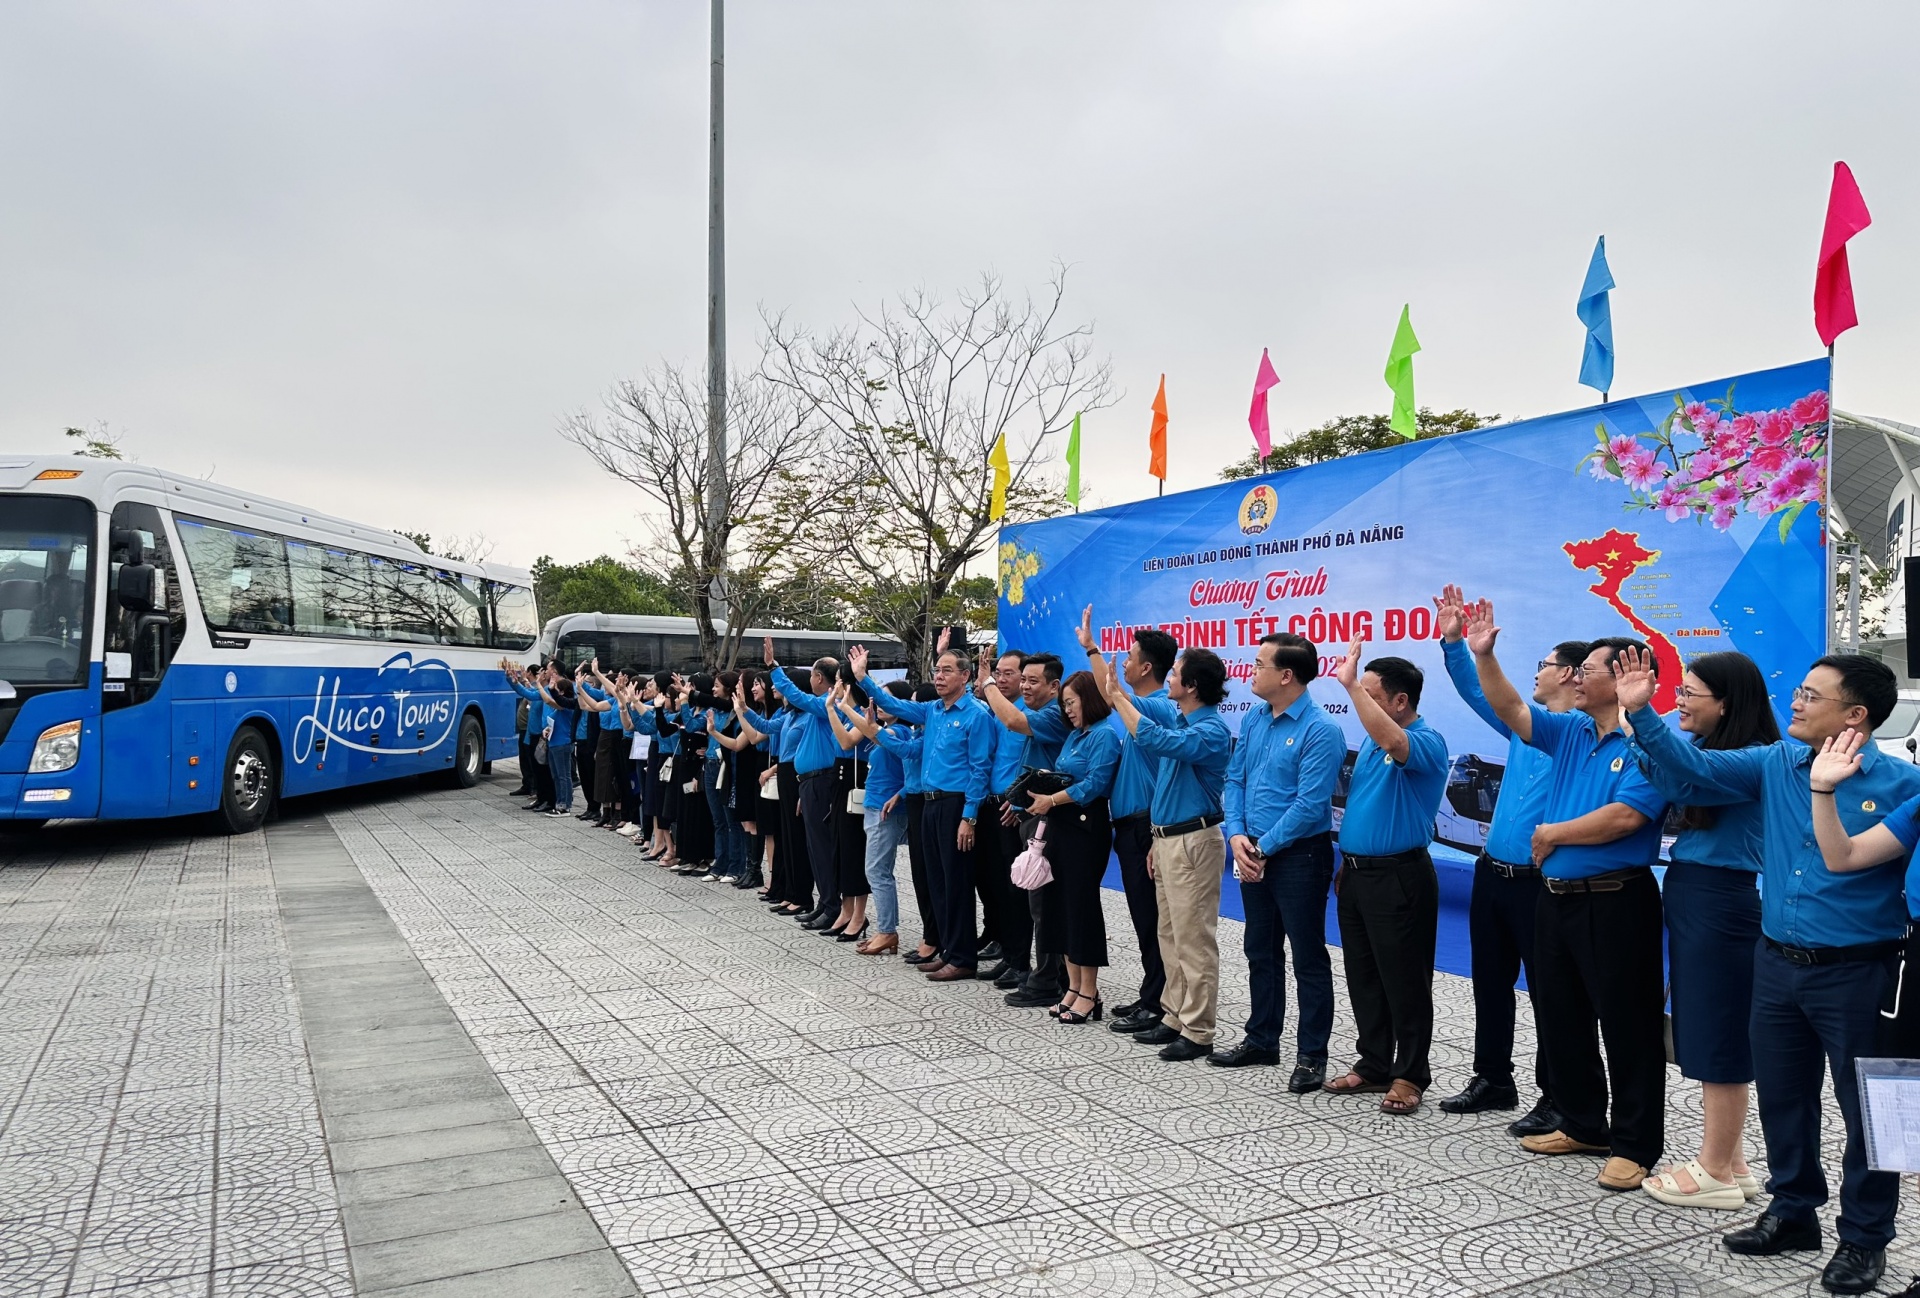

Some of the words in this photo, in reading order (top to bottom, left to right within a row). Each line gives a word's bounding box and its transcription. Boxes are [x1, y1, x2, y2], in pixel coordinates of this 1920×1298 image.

[1143, 558, 1164, 571] LIÊN
[1167, 553, 1194, 568] ĐOÀN
[1197, 550, 1217, 564] LAO
[1220, 545, 1251, 562] ĐỘNG
[1255, 539, 1299, 556] THÀNH
[1303, 530, 1331, 550] PHỐ
[1335, 529, 1355, 546] ĐÀ
[1360, 523, 1404, 543] NẴNG
[1189, 577, 1259, 608] Chương
[1265, 565, 1328, 600] Trình
[1101, 621, 1152, 652] HÀN
[1234, 608, 1279, 647] TẾT
[1288, 607, 1373, 644] CÔNG
[1384, 598, 1481, 641] ĐO
[293, 675, 386, 764] Huco
[393, 689, 450, 738] Tours
[1240, 702, 1251, 712] 07
[1323, 703, 1349, 715] 2024
